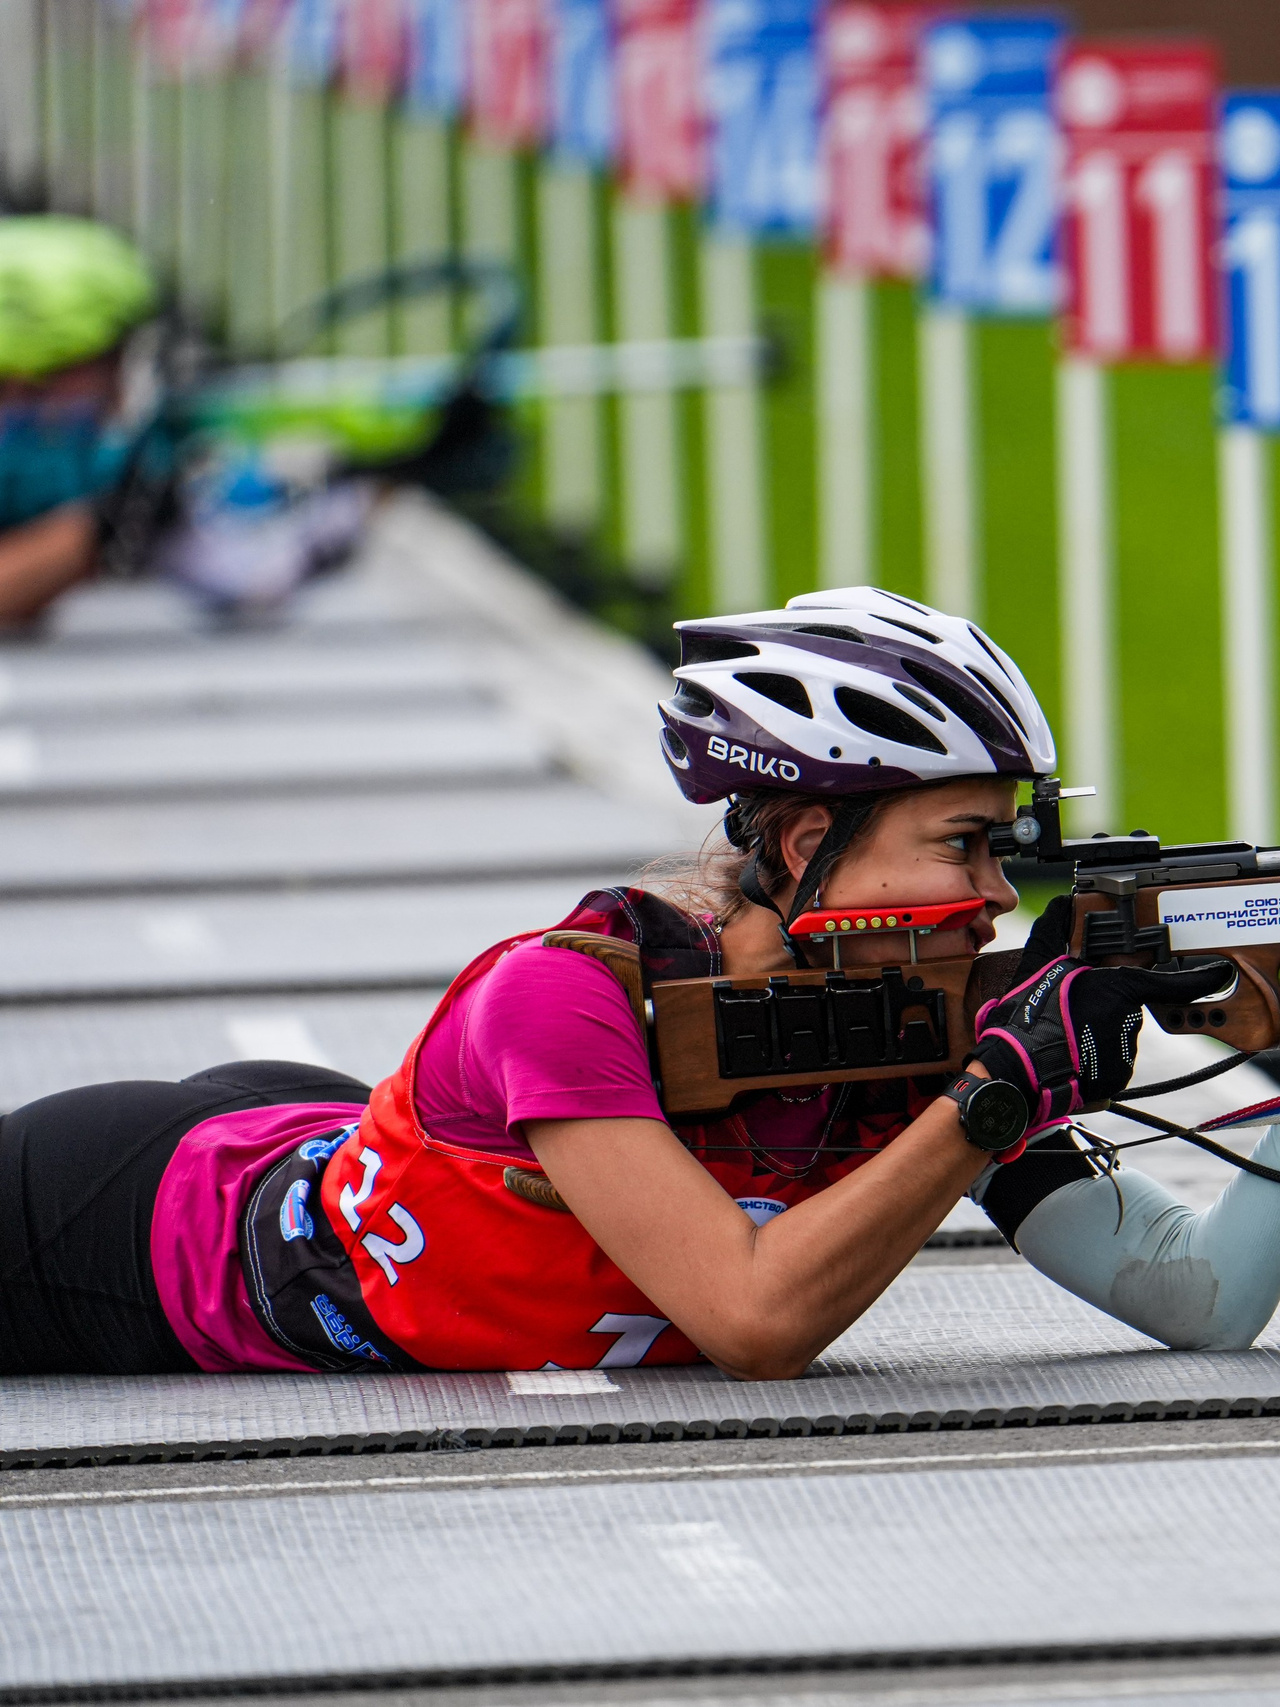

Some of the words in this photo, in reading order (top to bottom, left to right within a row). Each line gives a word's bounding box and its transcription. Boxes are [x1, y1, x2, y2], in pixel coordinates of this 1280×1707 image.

[934, 116, 1066, 306] 12
[1074, 152, 1202, 358] 11
[706, 735, 800, 782] BRIKO
[1029, 964, 1065, 1007] EasySki
[339, 1145, 426, 1287] 22
